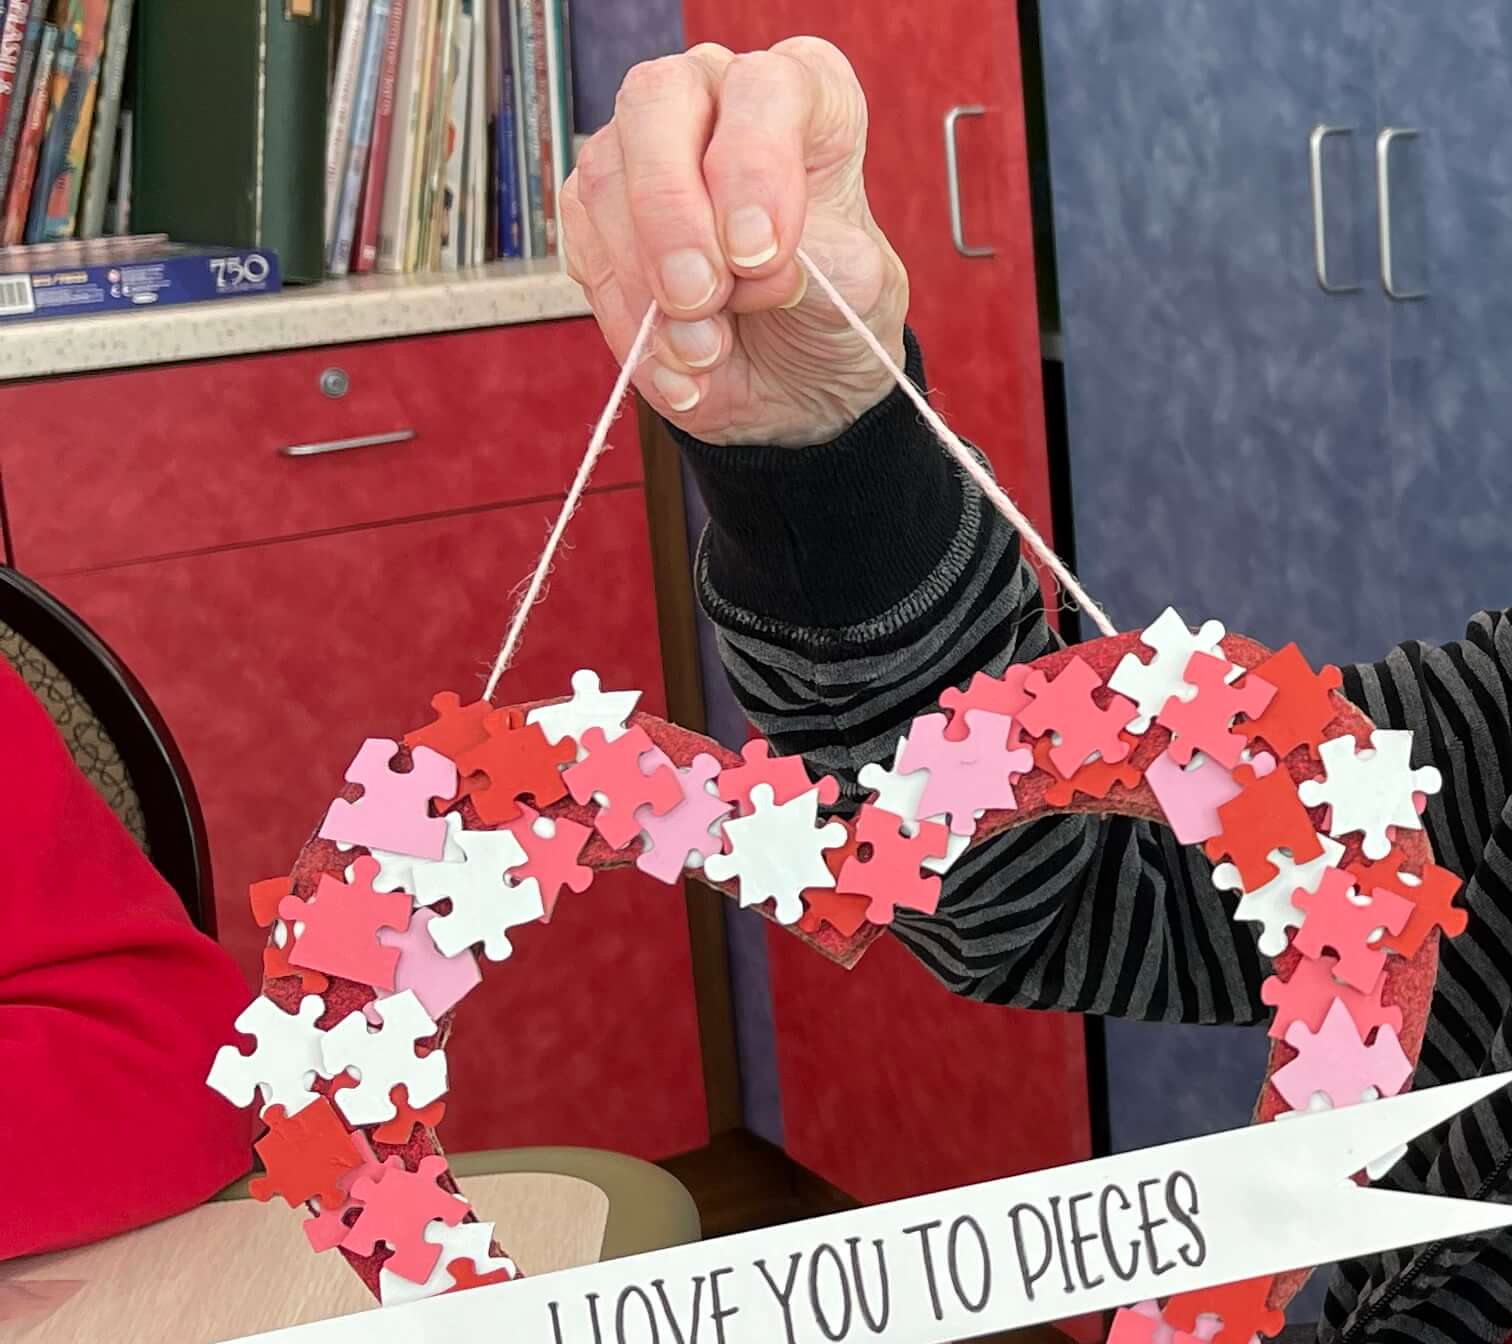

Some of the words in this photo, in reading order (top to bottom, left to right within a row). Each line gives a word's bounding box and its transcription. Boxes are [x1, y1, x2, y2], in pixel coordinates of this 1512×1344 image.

[208, 253, 270, 288] 750
[902, 1215, 991, 1321] TO
[1007, 1171, 1206, 1300] PIECES
